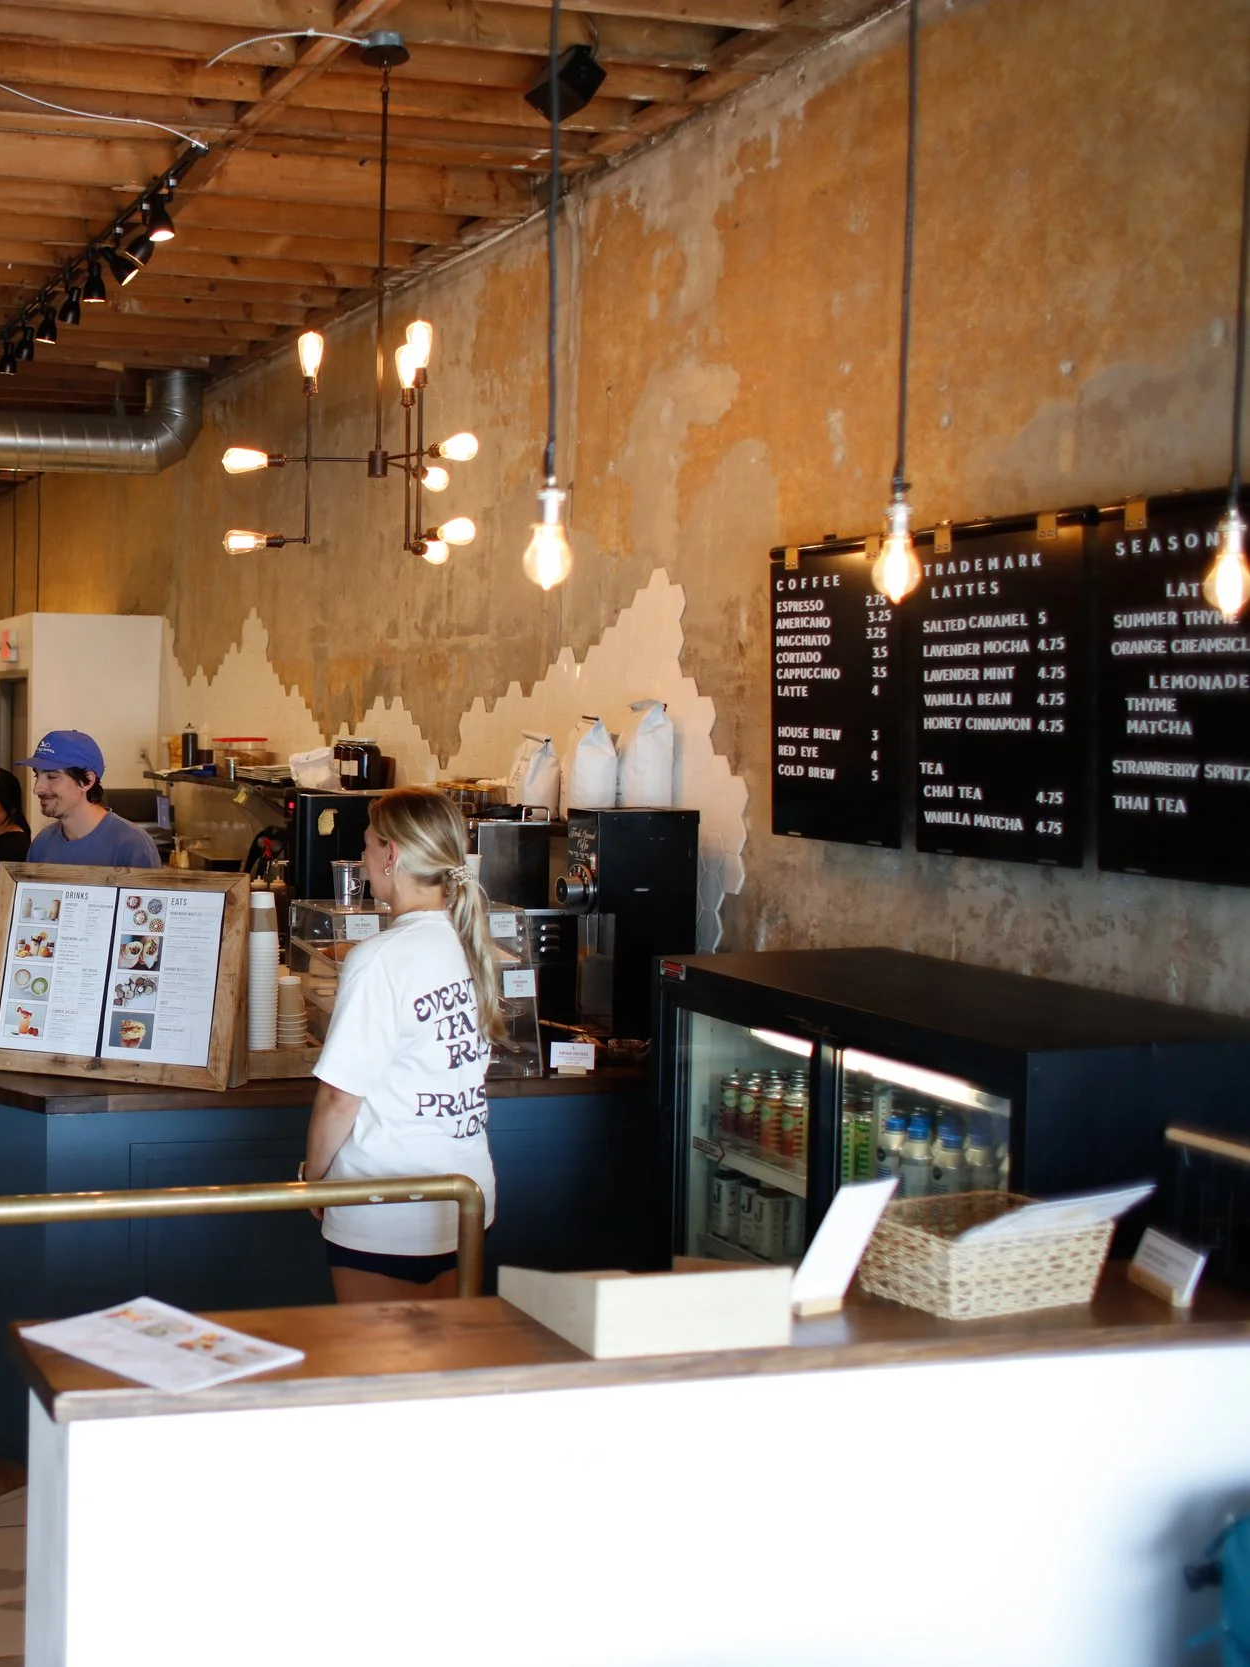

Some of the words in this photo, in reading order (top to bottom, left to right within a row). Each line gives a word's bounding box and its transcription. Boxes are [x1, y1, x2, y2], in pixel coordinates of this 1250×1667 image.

[1115, 532, 1219, 556] SEASON
[923, 553, 1042, 577] TRADEMARK
[776, 574, 840, 591] COFFEE
[931, 581, 999, 600] LATTES
[1166, 582, 1200, 597] LAT
[776, 599, 824, 613] ESPRESSO
[865, 595, 887, 607] 2.75
[776, 616, 831, 630] AMERICANO
[867, 610, 891, 623] 3.25
[922, 618, 966, 633] SALTED
[968, 613, 1029, 629] CARAMEL
[1038, 611, 1047, 625] 5
[1113, 611, 1178, 629] SUMMER
[776, 634, 831, 647] MACCHIATO
[865, 627, 887, 640] 3.25
[776, 651, 821, 664] CORTADO
[872, 646, 888, 659] 3.5
[923, 642, 980, 658] LAVENDER
[983, 639, 1030, 654] MOCHA
[1037, 636, 1066, 651] 4.75
[1110, 639, 1167, 656] ORANGE
[1170, 637, 1250, 654] CREAMSICL
[776, 667, 841, 680] CAPPUCCINO
[872, 666, 887, 678] 3.5
[924, 668, 980, 683] LAVENDER
[983, 665, 1015, 681] MINT
[1037, 665, 1066, 680] 4.75
[1149, 674, 1250, 690] LEMONADE
[777, 685, 808, 697] LATTE
[871, 684, 879, 696] 4
[923, 693, 972, 707] VANILLA
[977, 692, 1011, 706] BEAN
[1036, 692, 1065, 706] 4.75
[1124, 697, 1177, 712] THYME
[777, 726, 809, 739] HOUSE
[813, 727, 841, 741] BREW
[871, 729, 879, 741] 3
[923, 717, 962, 730] HONEY
[965, 717, 1031, 731] CINNAMON
[1037, 719, 1064, 733] 4.75
[1126, 719, 1192, 735] MATCHA
[778, 744, 796, 756] RED
[800, 746, 819, 758] EYE
[870, 750, 879, 761] 4
[777, 764, 804, 776] COLD
[808, 766, 835, 780] BREW
[871, 769, 879, 781] 5
[919, 761, 944, 775] TEA
[1112, 760, 1200, 778] STRAWBERRY
[923, 785, 953, 798] CHAI
[958, 786, 983, 800] TEA
[1036, 791, 1063, 805] 4.75
[1112, 795, 1149, 810] THAI
[1154, 797, 1187, 813] TEA
[924, 811, 970, 826] VANILLA
[973, 814, 1024, 831] MATCHA
[1035, 820, 1063, 835] 4.75
[65, 891, 89, 900] DRINKS
[171, 897, 188, 906] EATS
[415, 1084, 487, 1118] PRAIS
